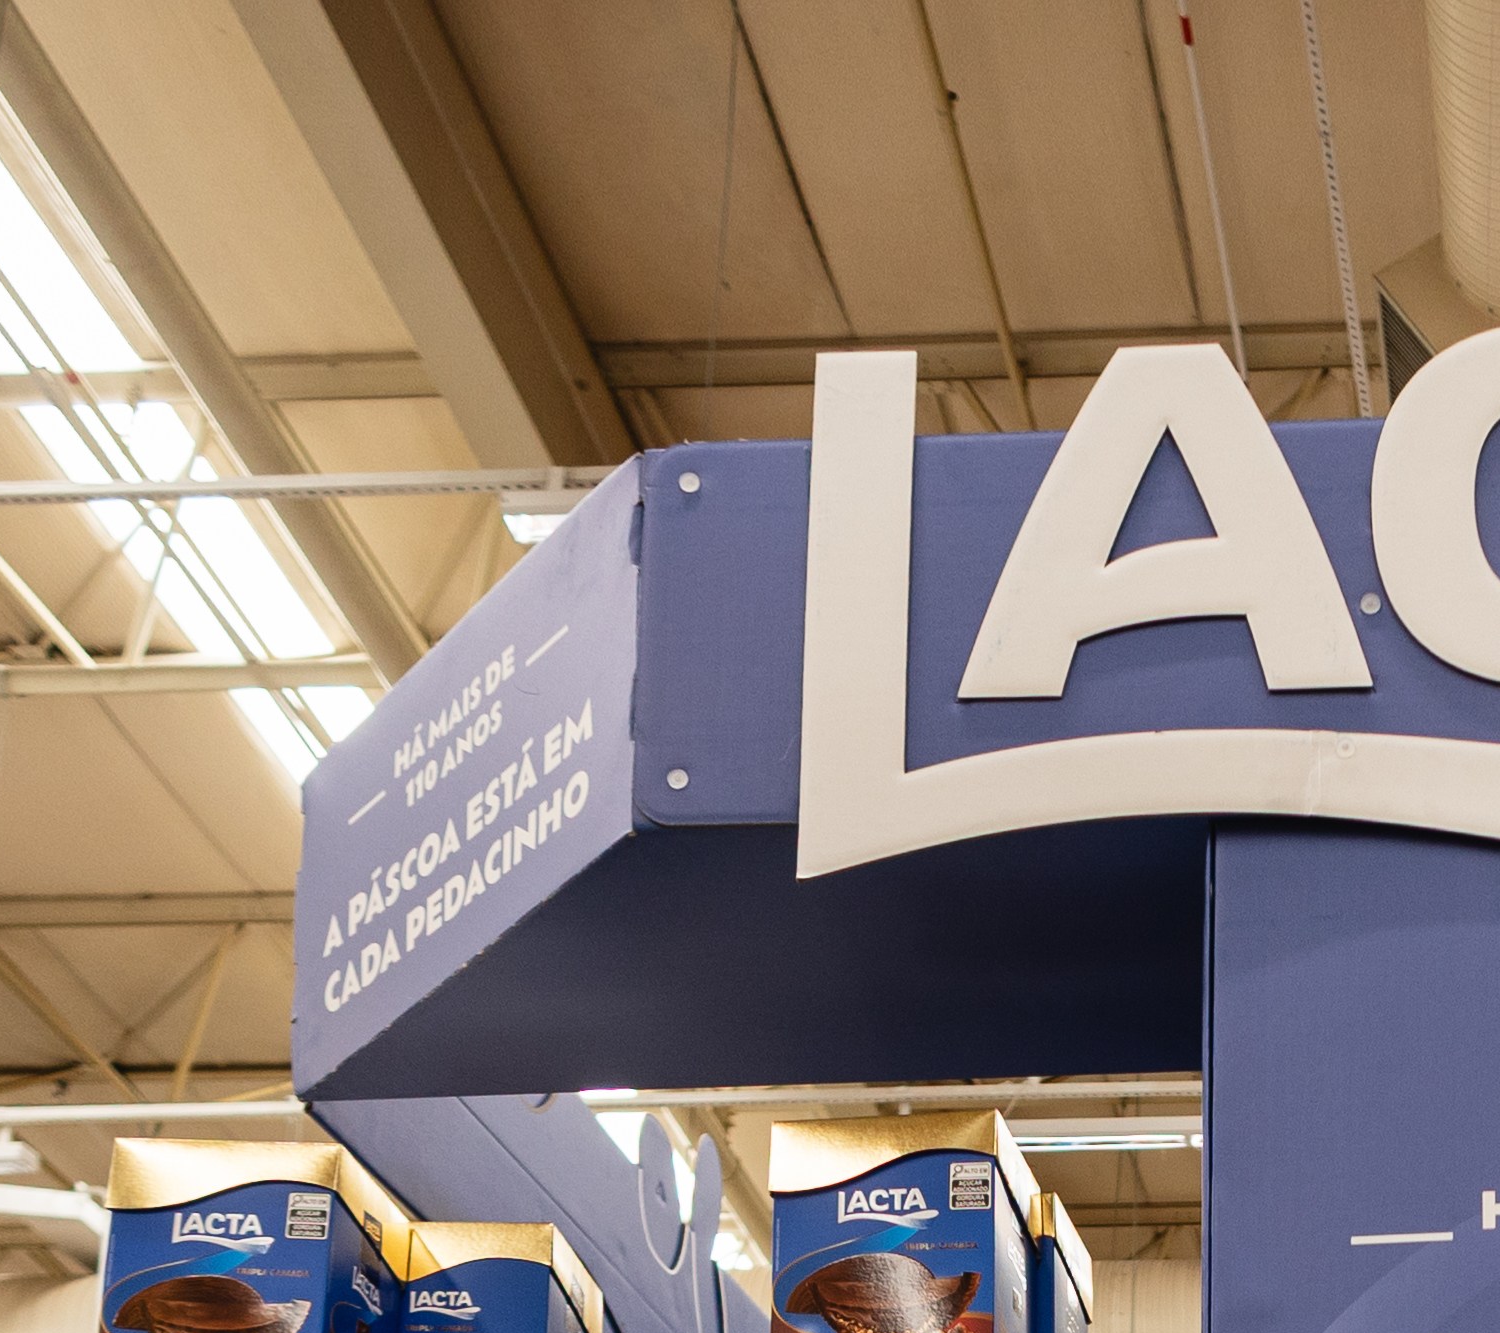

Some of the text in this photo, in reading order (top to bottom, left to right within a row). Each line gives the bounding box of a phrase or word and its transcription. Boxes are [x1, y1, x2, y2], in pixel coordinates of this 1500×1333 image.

[394, 645, 515, 778] HÁ MAIS DE
[406, 701, 502, 806] 110 ANOS
[322, 698, 593, 957] A PÁSCOA ESTÁ EM
[324, 770, 589, 1012] CADA PEDACINHO
[171, 1212, 270, 1248] LACTA
[838, 1187, 936, 1223] LACTA
[410, 1289, 477, 1316] LACTA
